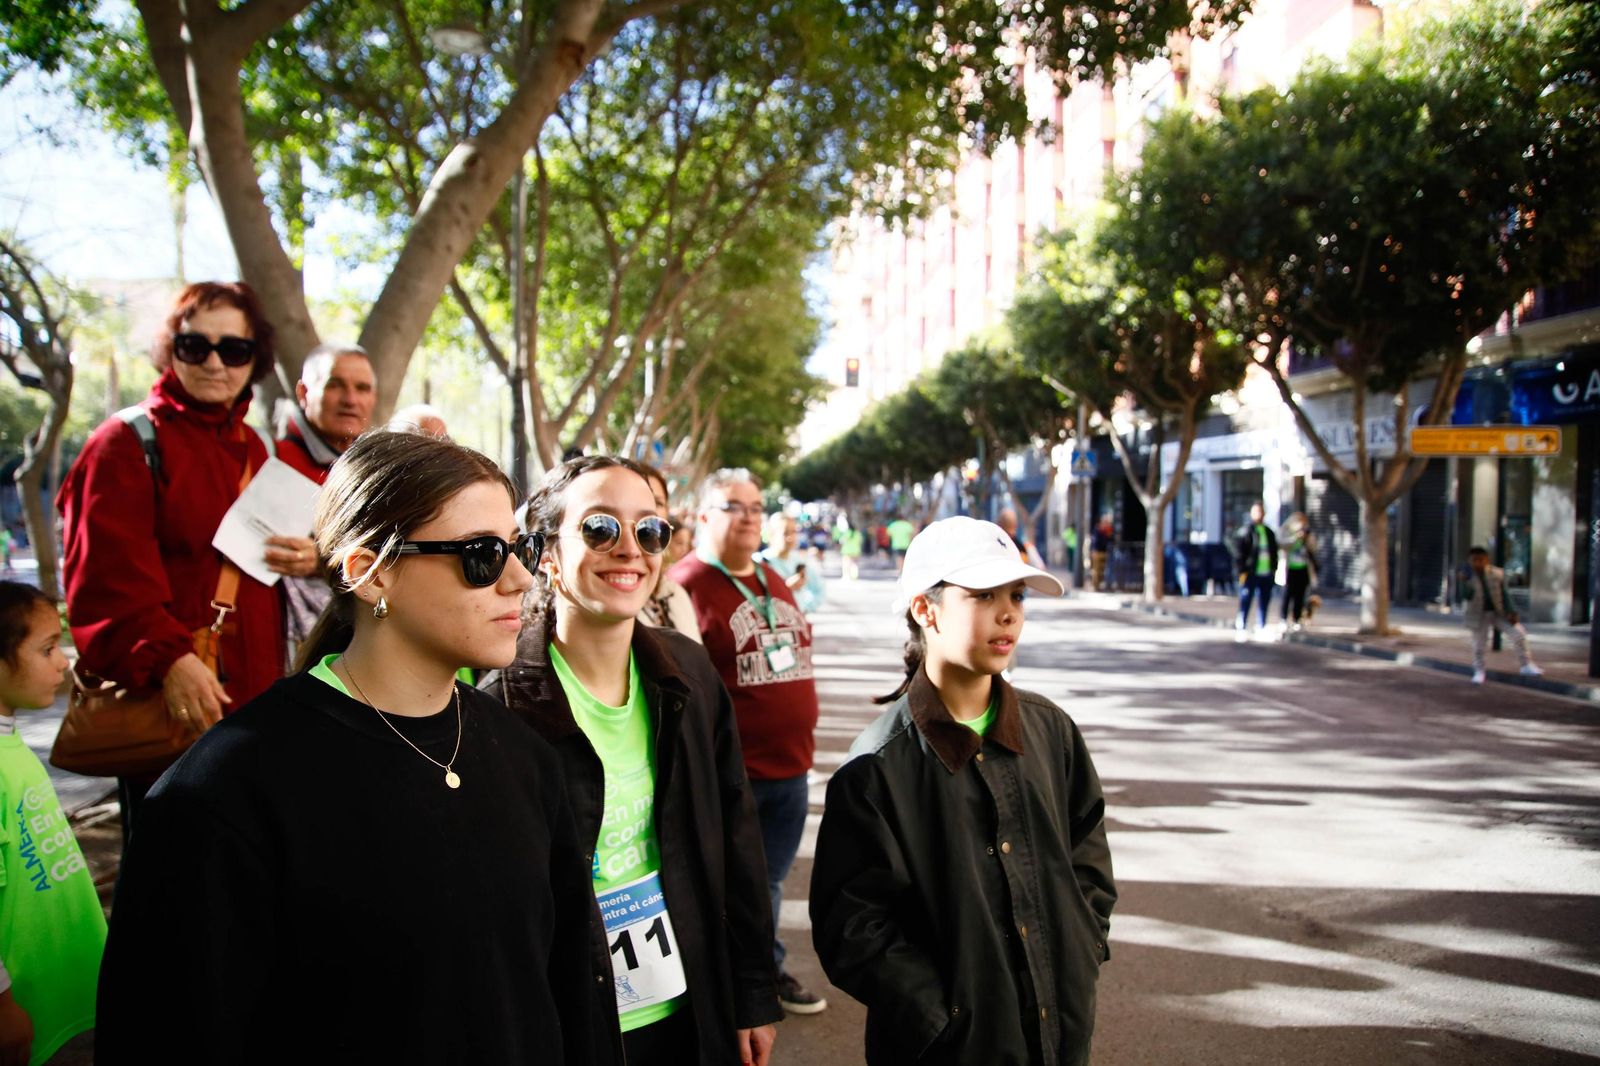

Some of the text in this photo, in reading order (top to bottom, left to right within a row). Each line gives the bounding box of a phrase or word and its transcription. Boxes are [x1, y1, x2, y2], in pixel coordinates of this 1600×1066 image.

[602, 907, 628, 921] ntra
[629, 901, 641, 912] el
[610, 916, 672, 971] 11
